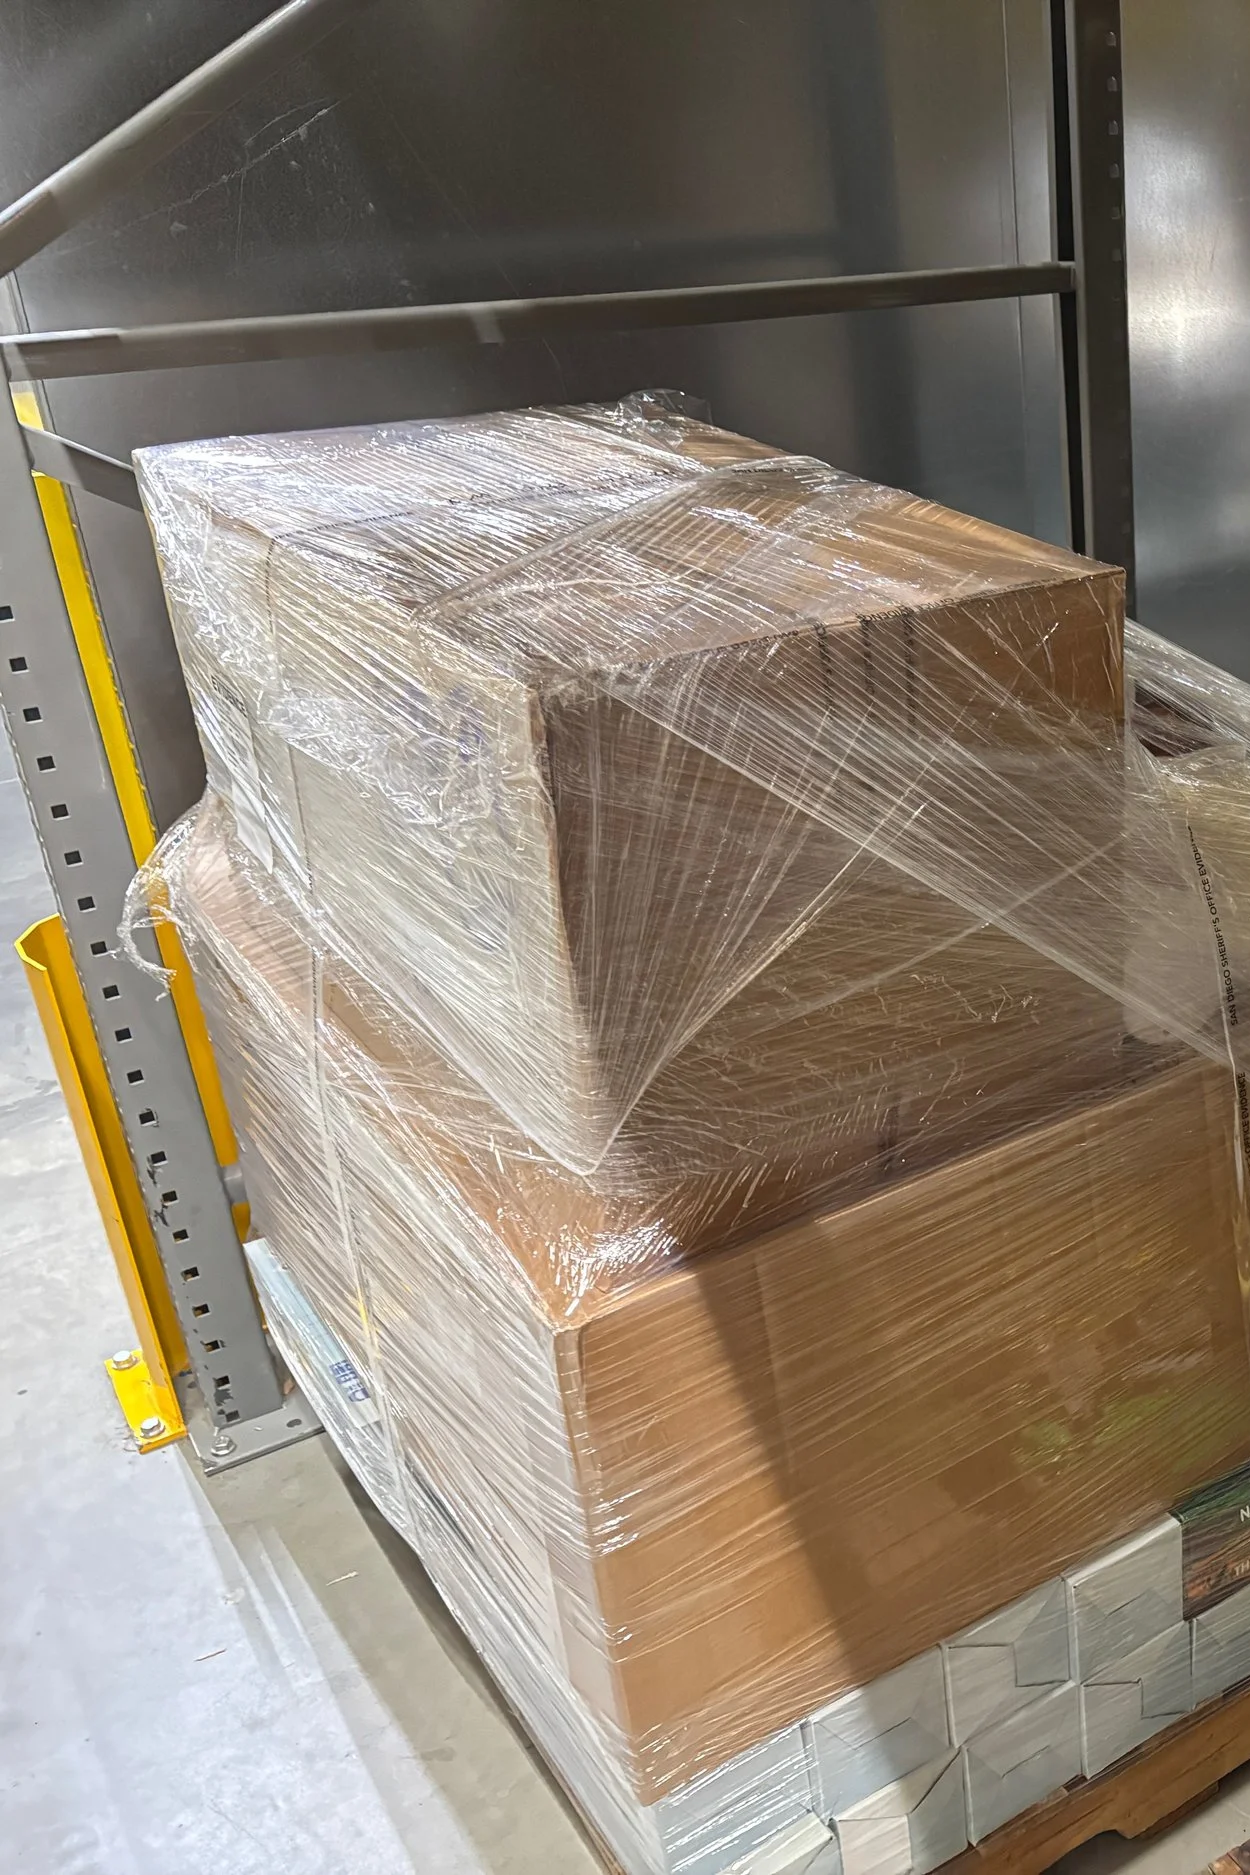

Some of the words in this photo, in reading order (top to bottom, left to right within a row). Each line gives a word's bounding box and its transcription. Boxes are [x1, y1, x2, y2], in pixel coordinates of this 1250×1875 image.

[1201, 876, 1218, 916] OFFICE
[1212, 916, 1229, 968] SHERIFF'S
[1223, 968, 1236, 1003] DIEGO
[1230, 1003, 1238, 1026] SAN
[1236, 1072, 1250, 1120] EVIDENCE
